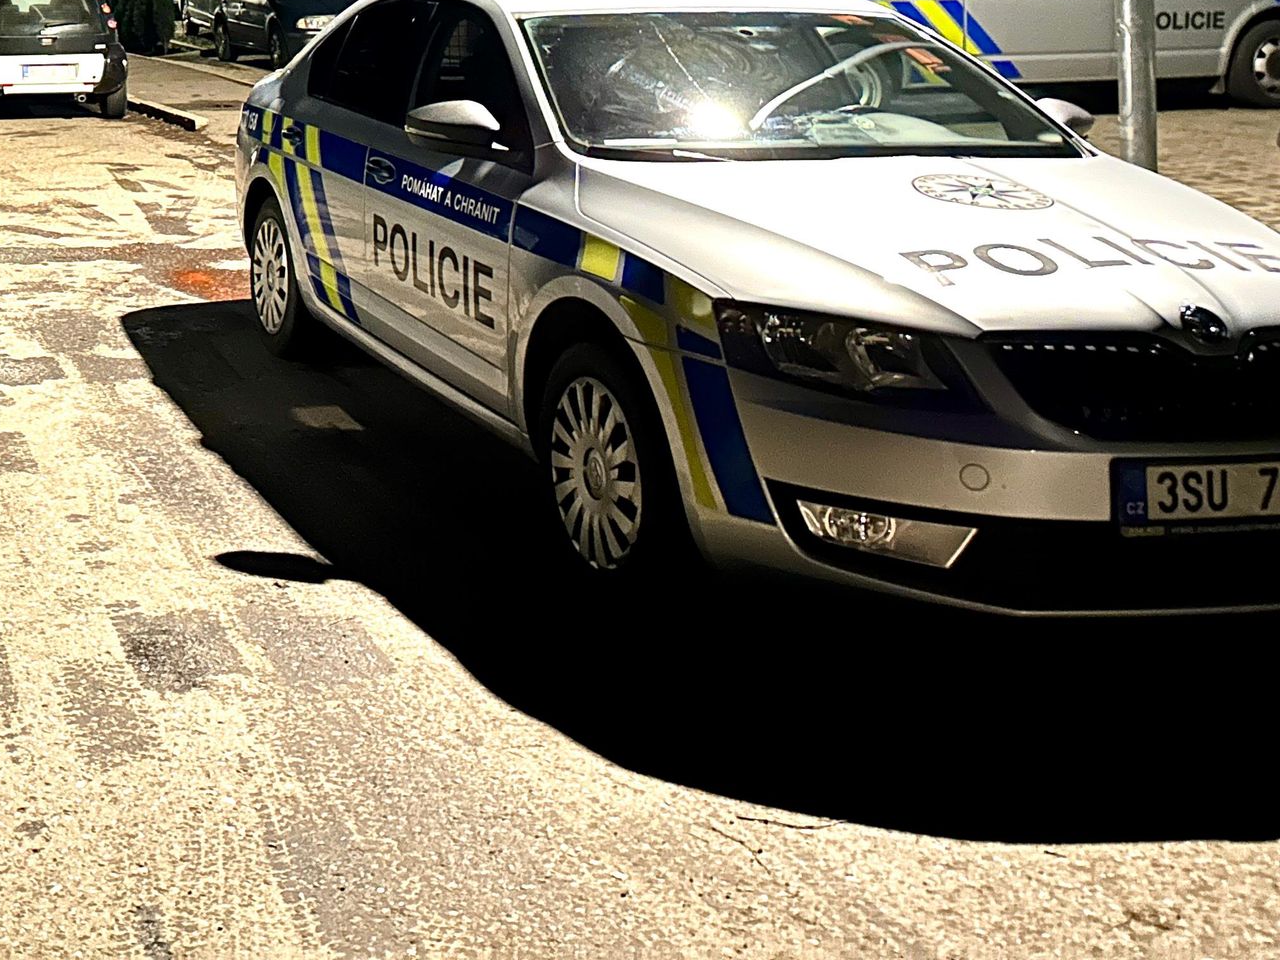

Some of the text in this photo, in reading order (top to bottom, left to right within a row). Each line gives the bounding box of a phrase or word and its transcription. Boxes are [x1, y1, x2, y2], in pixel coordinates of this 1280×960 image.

[1156, 11, 1225, 30] OLICIE
[401, 174, 501, 225] POMÁHAT A CHRÁNIT
[373, 213, 495, 330] POLICIE
[898, 236, 1280, 286] POLICIE
[1126, 502, 1145, 515] CZ
[1157, 467, 1279, 513] 3SU 7
